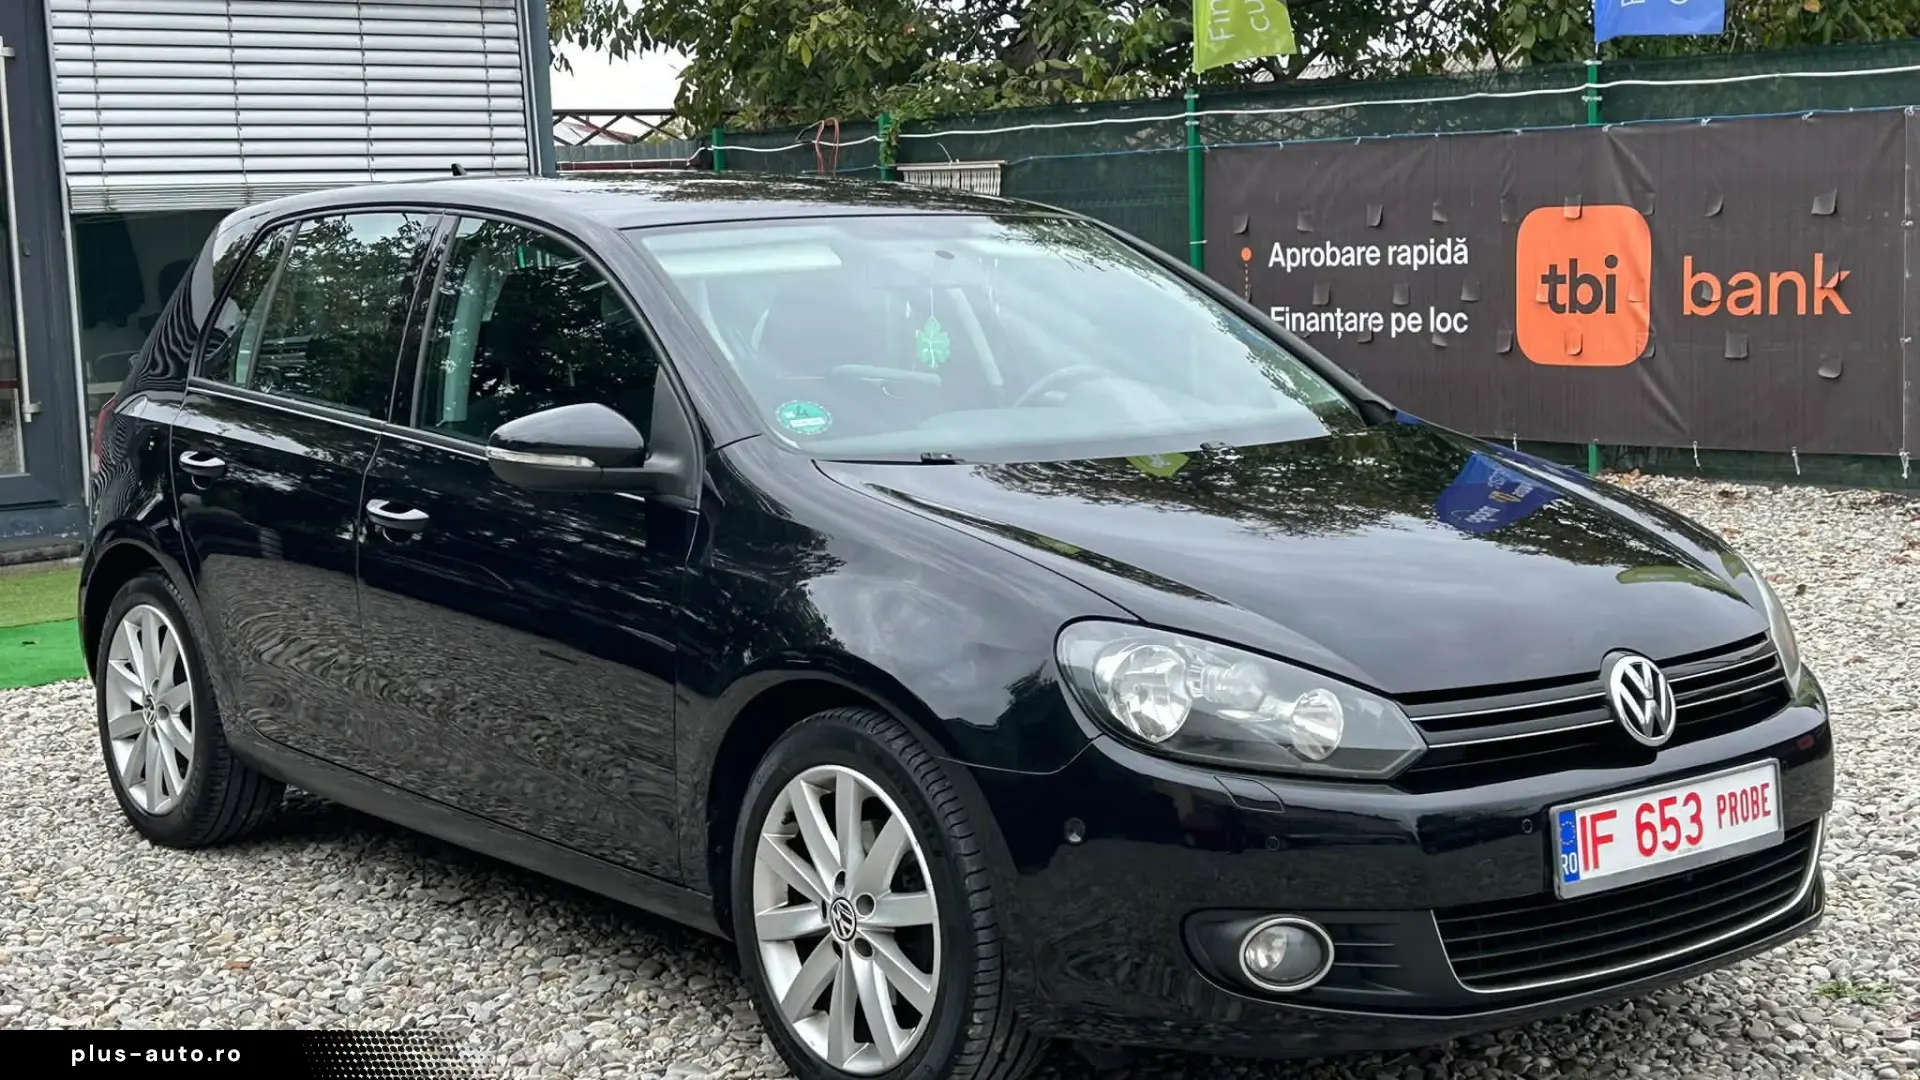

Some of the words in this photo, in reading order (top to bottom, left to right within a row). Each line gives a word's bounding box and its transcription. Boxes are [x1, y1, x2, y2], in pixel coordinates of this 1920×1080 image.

[1268, 241, 1381, 272] Aprobare
[1388, 237, 1469, 271] rapidă
[1541, 254, 1619, 315] tbi
[1683, 252, 1852, 317] bank
[1270, 306, 1384, 339] Finanțare
[1391, 311, 1423, 338] pe
[1430, 306, 1469, 333] loc
[1580, 809, 1617, 871] IF
[1635, 791, 1704, 857] 653
[1716, 782, 1771, 830] PROBE
